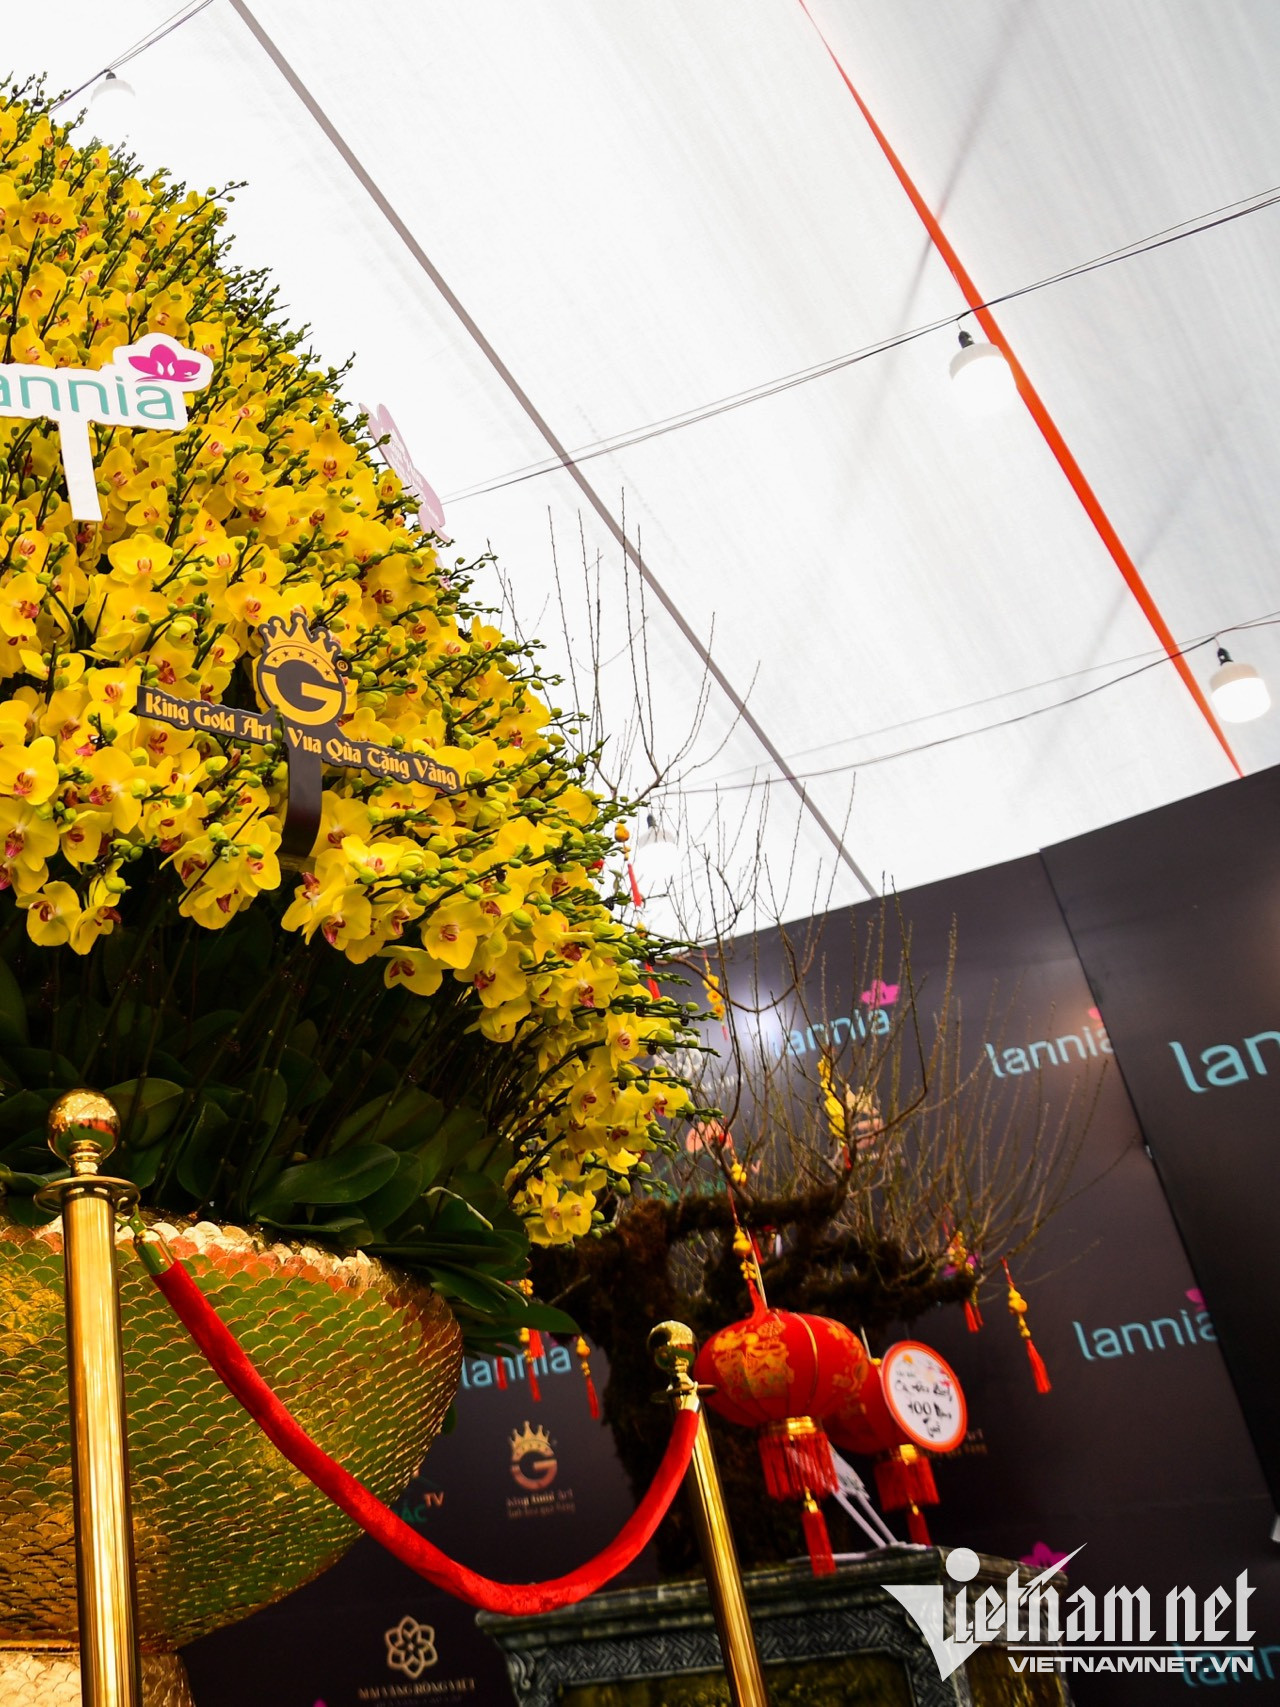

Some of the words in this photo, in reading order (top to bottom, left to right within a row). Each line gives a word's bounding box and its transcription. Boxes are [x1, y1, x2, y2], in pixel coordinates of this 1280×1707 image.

[146, 693, 189, 725] King
[194, 706, 235, 733] Gold
[240, 716, 273, 741] Art
[287, 727, 322, 754] Vua
[366, 749, 410, 779] Tặng
[413, 758, 457, 790] Vàng
[1072, 1309, 1217, 1361] lannia
[424, 1491, 445, 1508] TV
